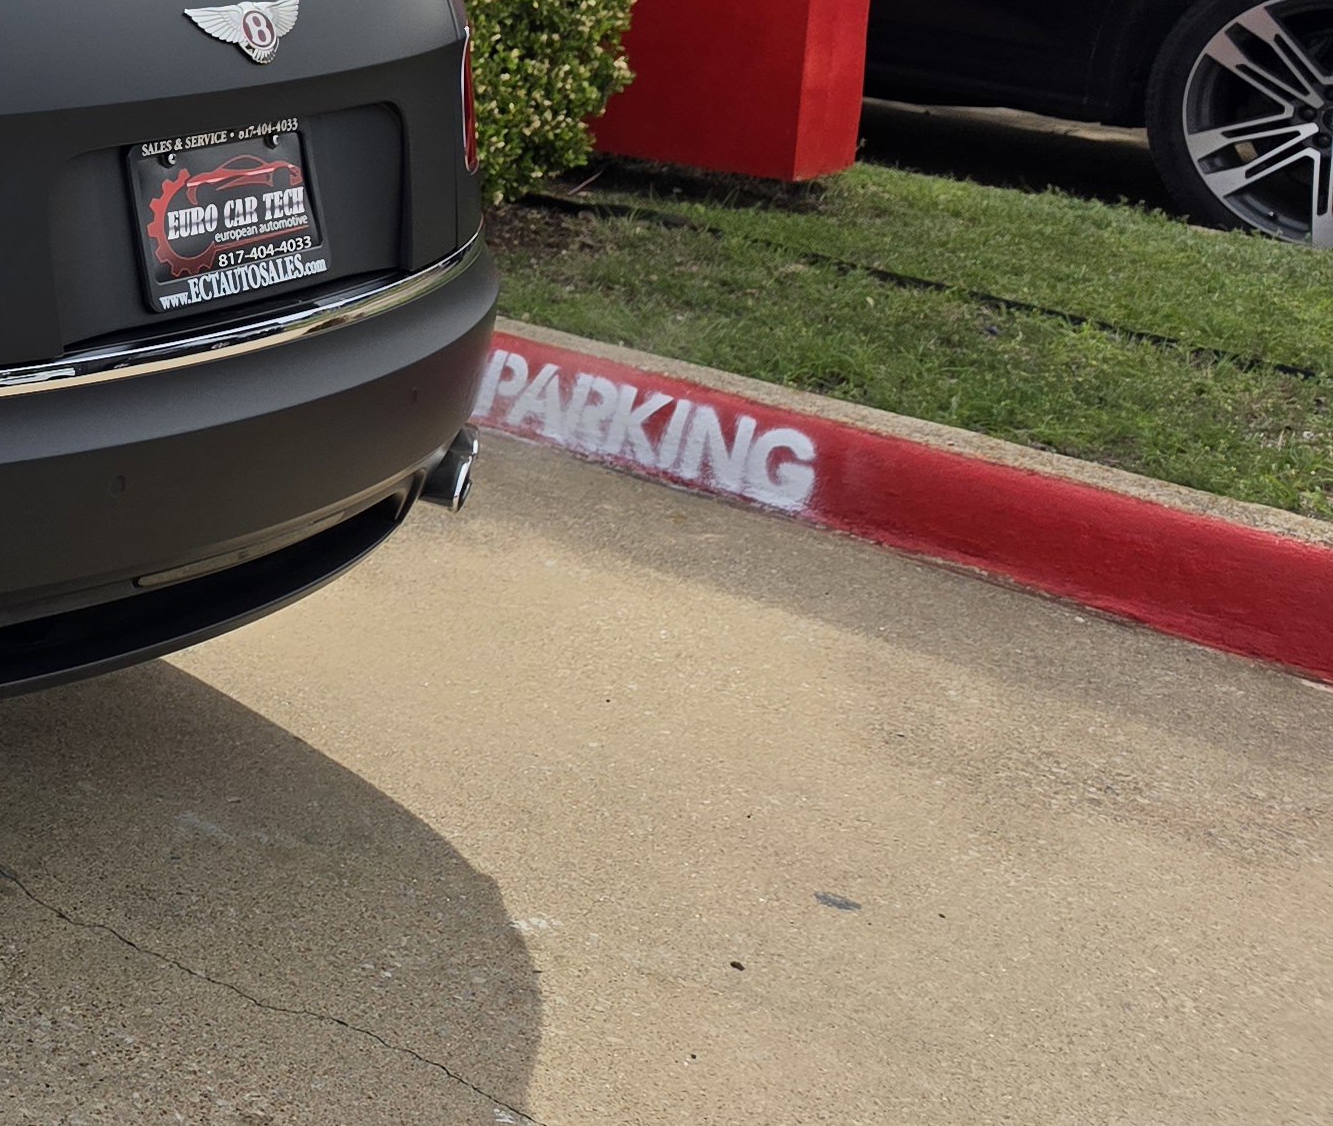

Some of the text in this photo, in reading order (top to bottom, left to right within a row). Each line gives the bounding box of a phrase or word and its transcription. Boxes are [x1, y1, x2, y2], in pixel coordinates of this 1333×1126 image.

[141, 117, 299, 157] SALES & SERVICE 817-404-4033
[167, 186, 306, 241] EURO CAR TECH
[214, 213, 309, 244] european automotive
[218, 235, 312, 268] 817-404-4033
[159, 253, 328, 311] www.ECTAUTOSALES.com
[471, 349, 818, 512] PARKING
